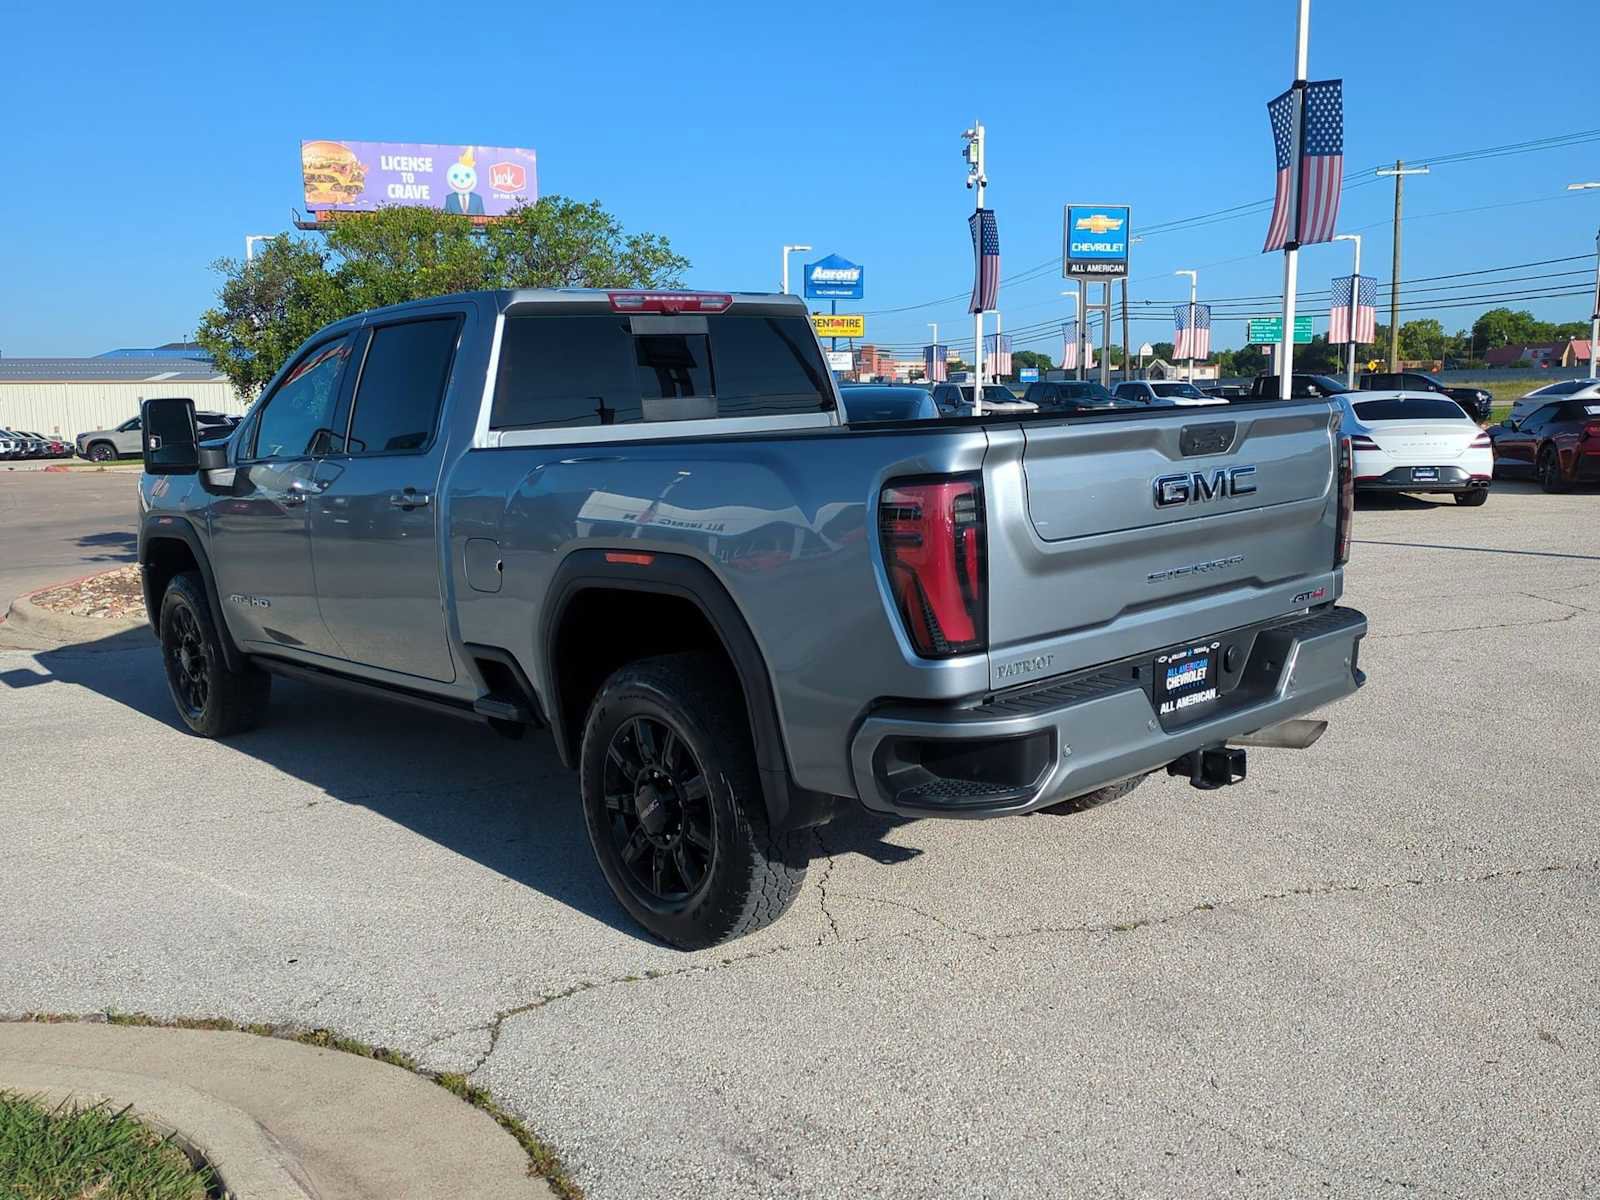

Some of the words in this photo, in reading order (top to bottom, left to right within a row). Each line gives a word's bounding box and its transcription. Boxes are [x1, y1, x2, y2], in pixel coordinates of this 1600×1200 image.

[381, 155, 433, 173] LICENSE
[401, 172, 415, 184] TO
[492, 167, 522, 188] Jack
[387, 184, 430, 199] CRAVE
[1072, 243, 1124, 252] CHEVROLET
[810, 266, 860, 281] Aaron's
[1071, 264, 1085, 272] ALL
[1087, 264, 1124, 272] AMERICAN
[1153, 464, 1257, 510] GMC
[996, 655, 1054, 680] PATRIOT
[1167, 666, 1178, 676] ALL
[1178, 658, 1208, 675] AMERICAN
[1166, 667, 1207, 690] CHEVROLET
[1160, 700, 1175, 715] ALL
[1176, 688, 1216, 709] AMERICAN
